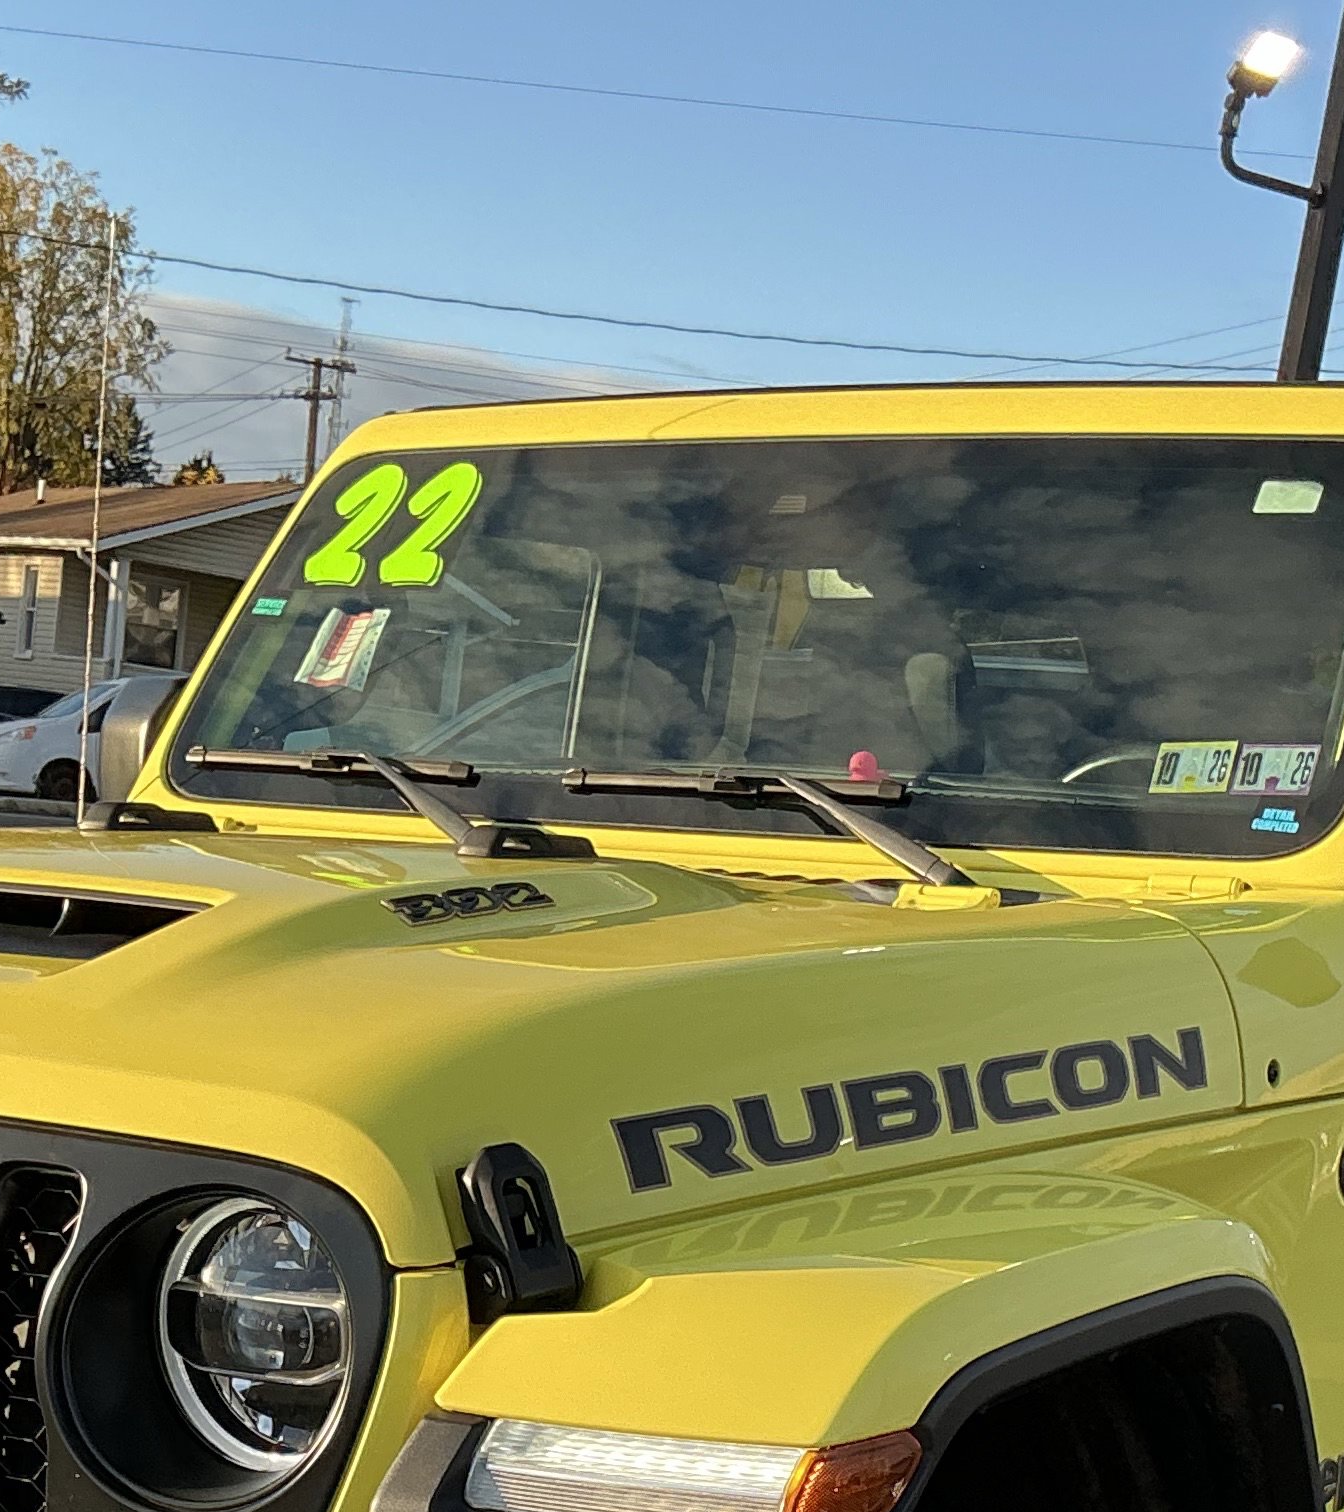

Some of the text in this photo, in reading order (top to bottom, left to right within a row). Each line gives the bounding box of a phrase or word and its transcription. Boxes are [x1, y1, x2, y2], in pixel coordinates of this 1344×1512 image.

[304, 462, 483, 587] 22
[1157, 749, 1232, 786] 10 26
[1239, 751, 1316, 786] 10 26
[610, 1027, 1208, 1193] RUBICON
